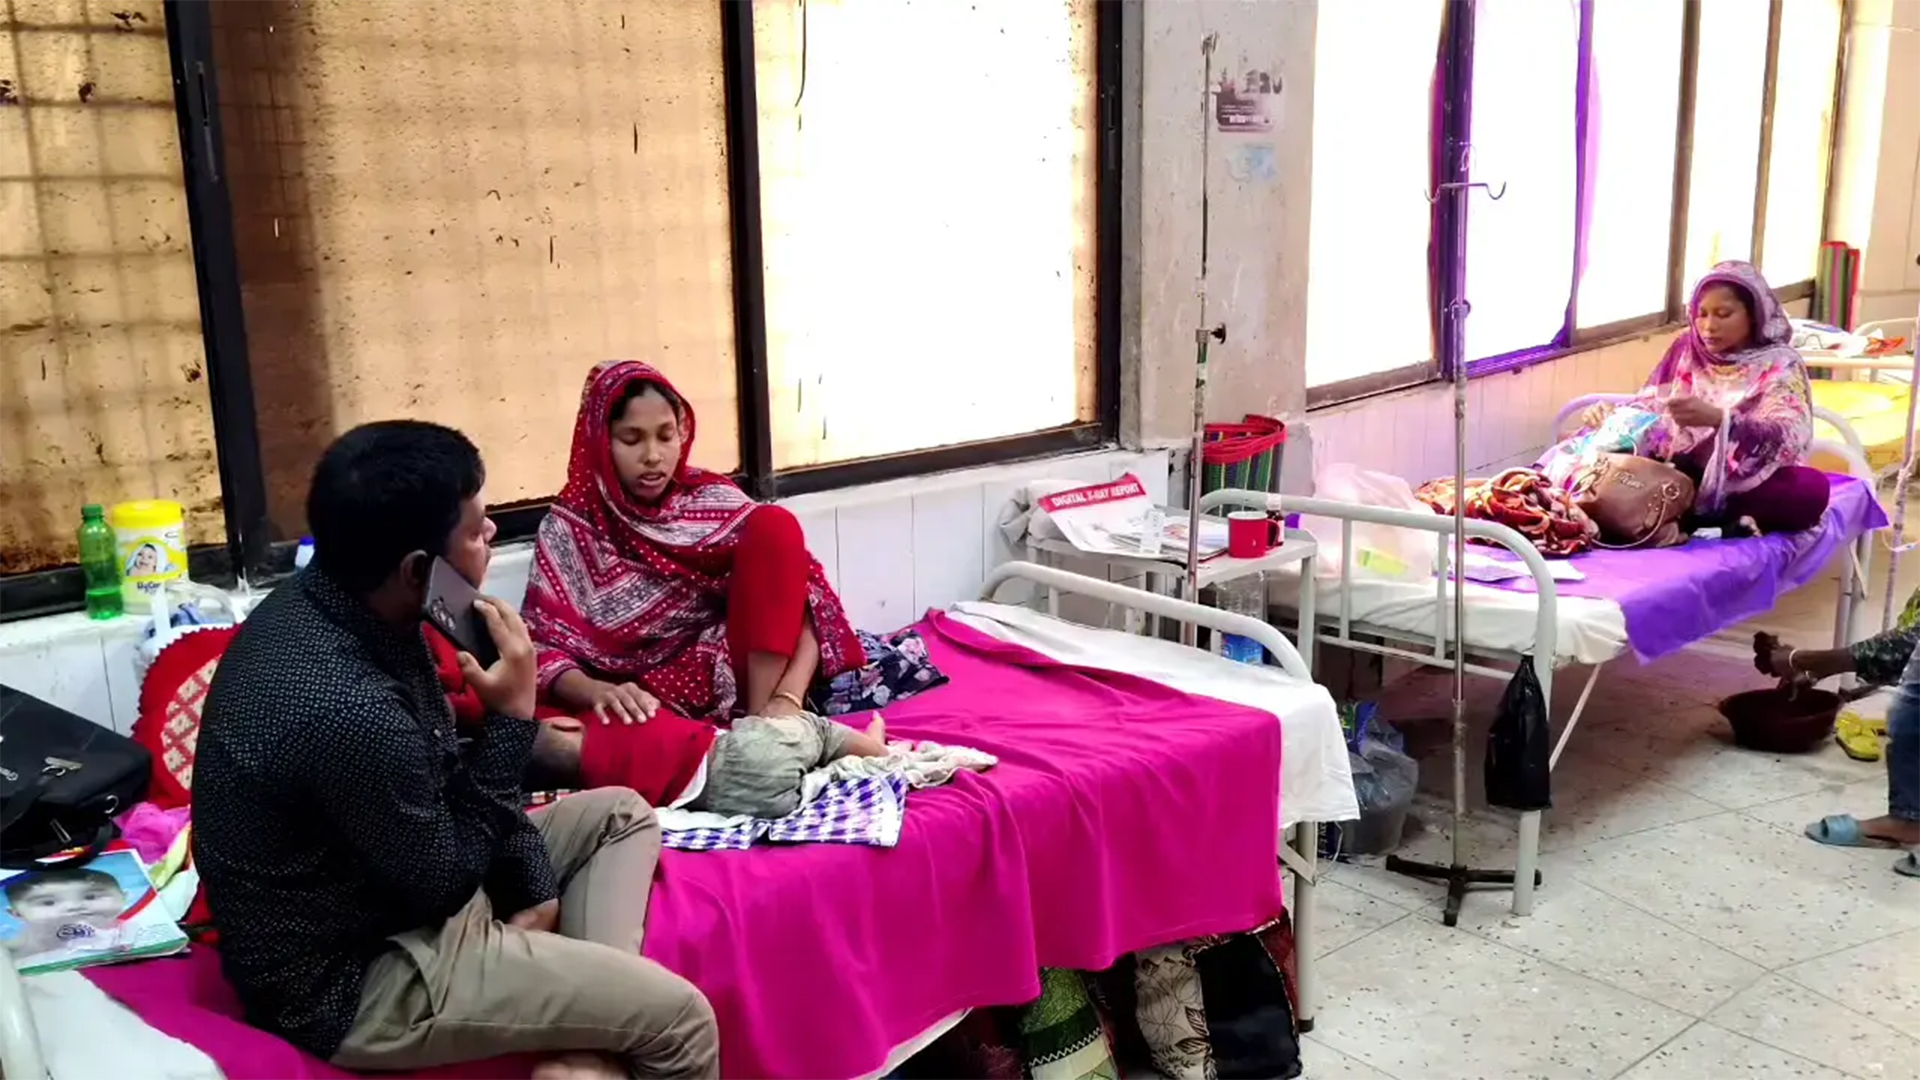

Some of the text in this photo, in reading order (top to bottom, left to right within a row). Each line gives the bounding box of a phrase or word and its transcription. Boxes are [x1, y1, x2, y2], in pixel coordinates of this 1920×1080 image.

[1051, 484, 1139, 507] DIGITAL X-RAY REPORT
